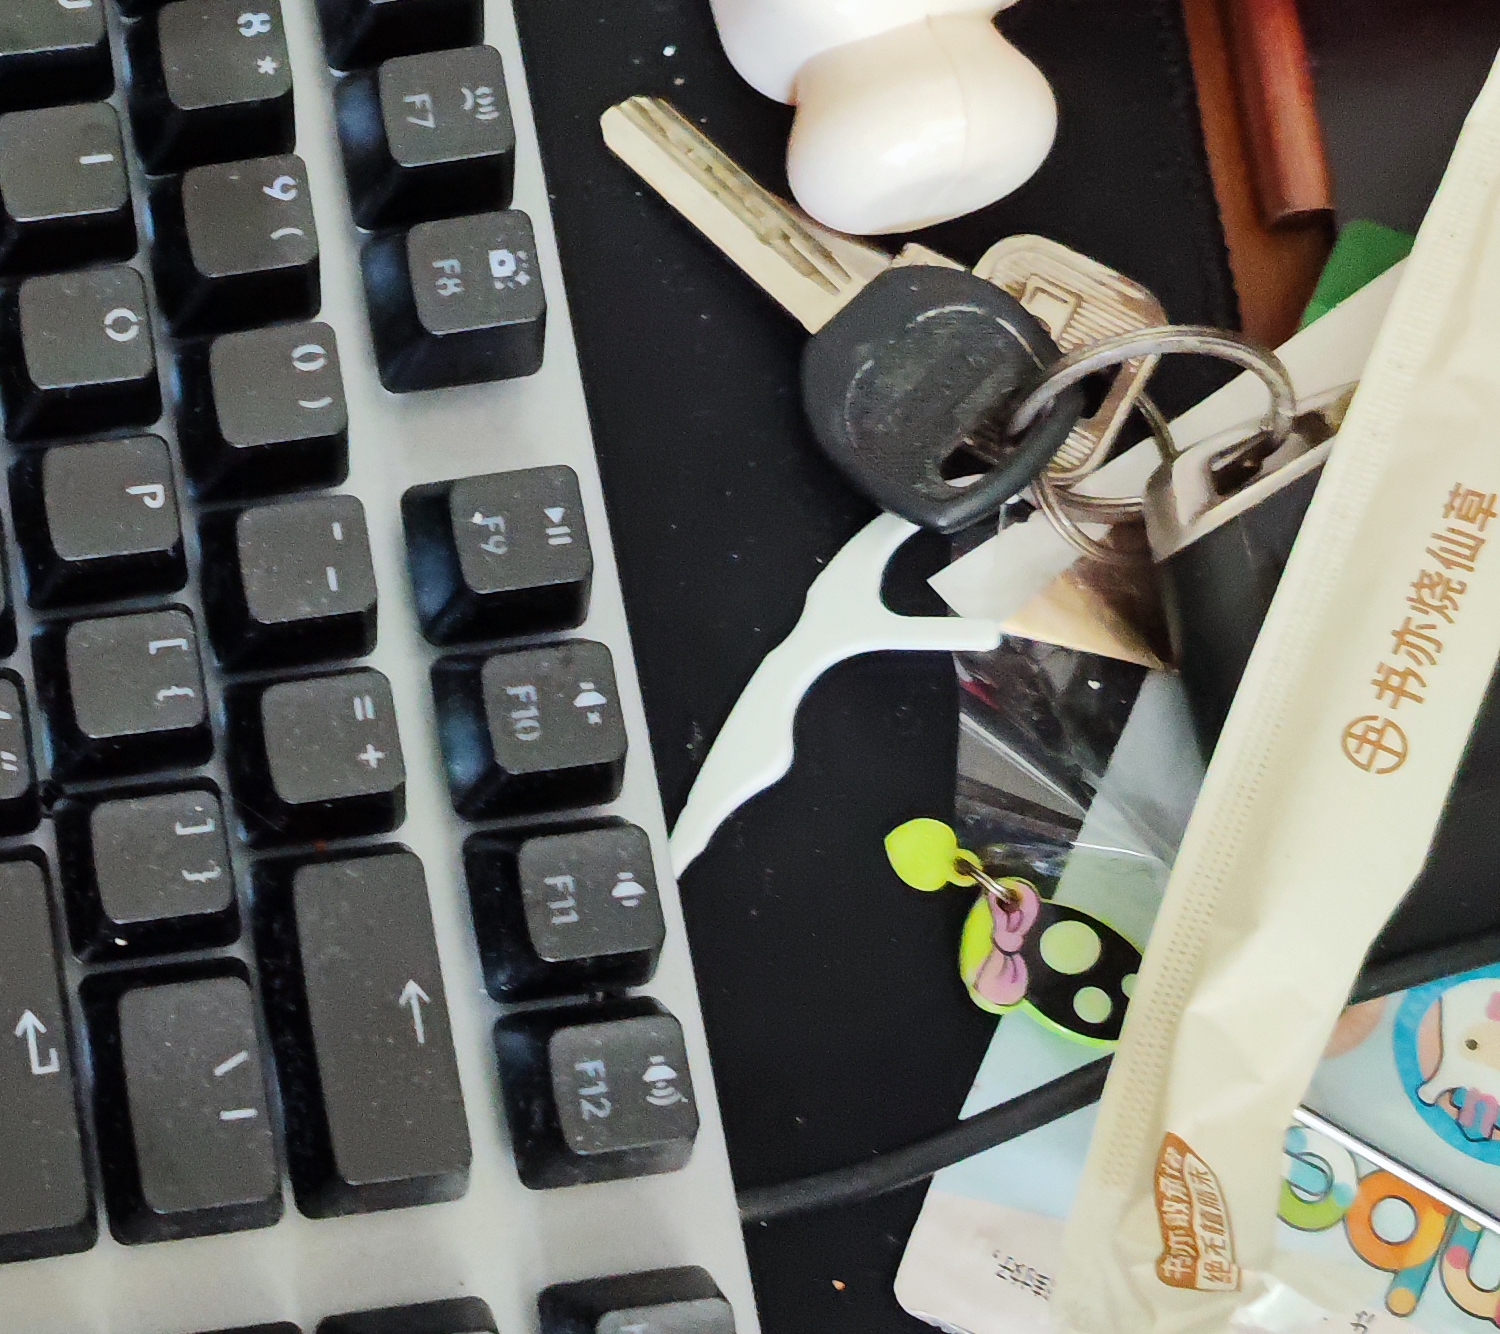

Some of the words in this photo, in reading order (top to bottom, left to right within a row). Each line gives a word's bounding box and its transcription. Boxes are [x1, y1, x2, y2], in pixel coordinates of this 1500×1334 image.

[237, 12, 271, 38] 8
[403, 93, 436, 129] F7
[263, 175, 298, 202] 9
[432, 258, 464, 297] F8
[291, 343, 326, 372] 0
[125, 483, 165, 509] P
[480, 516, 508, 554] F9
[1370, 481, 1499, 712] 书亦烧仙草
[506, 684, 541, 742] F10
[543, 874, 579, 925] F11
[574, 1057, 611, 1120] F12
